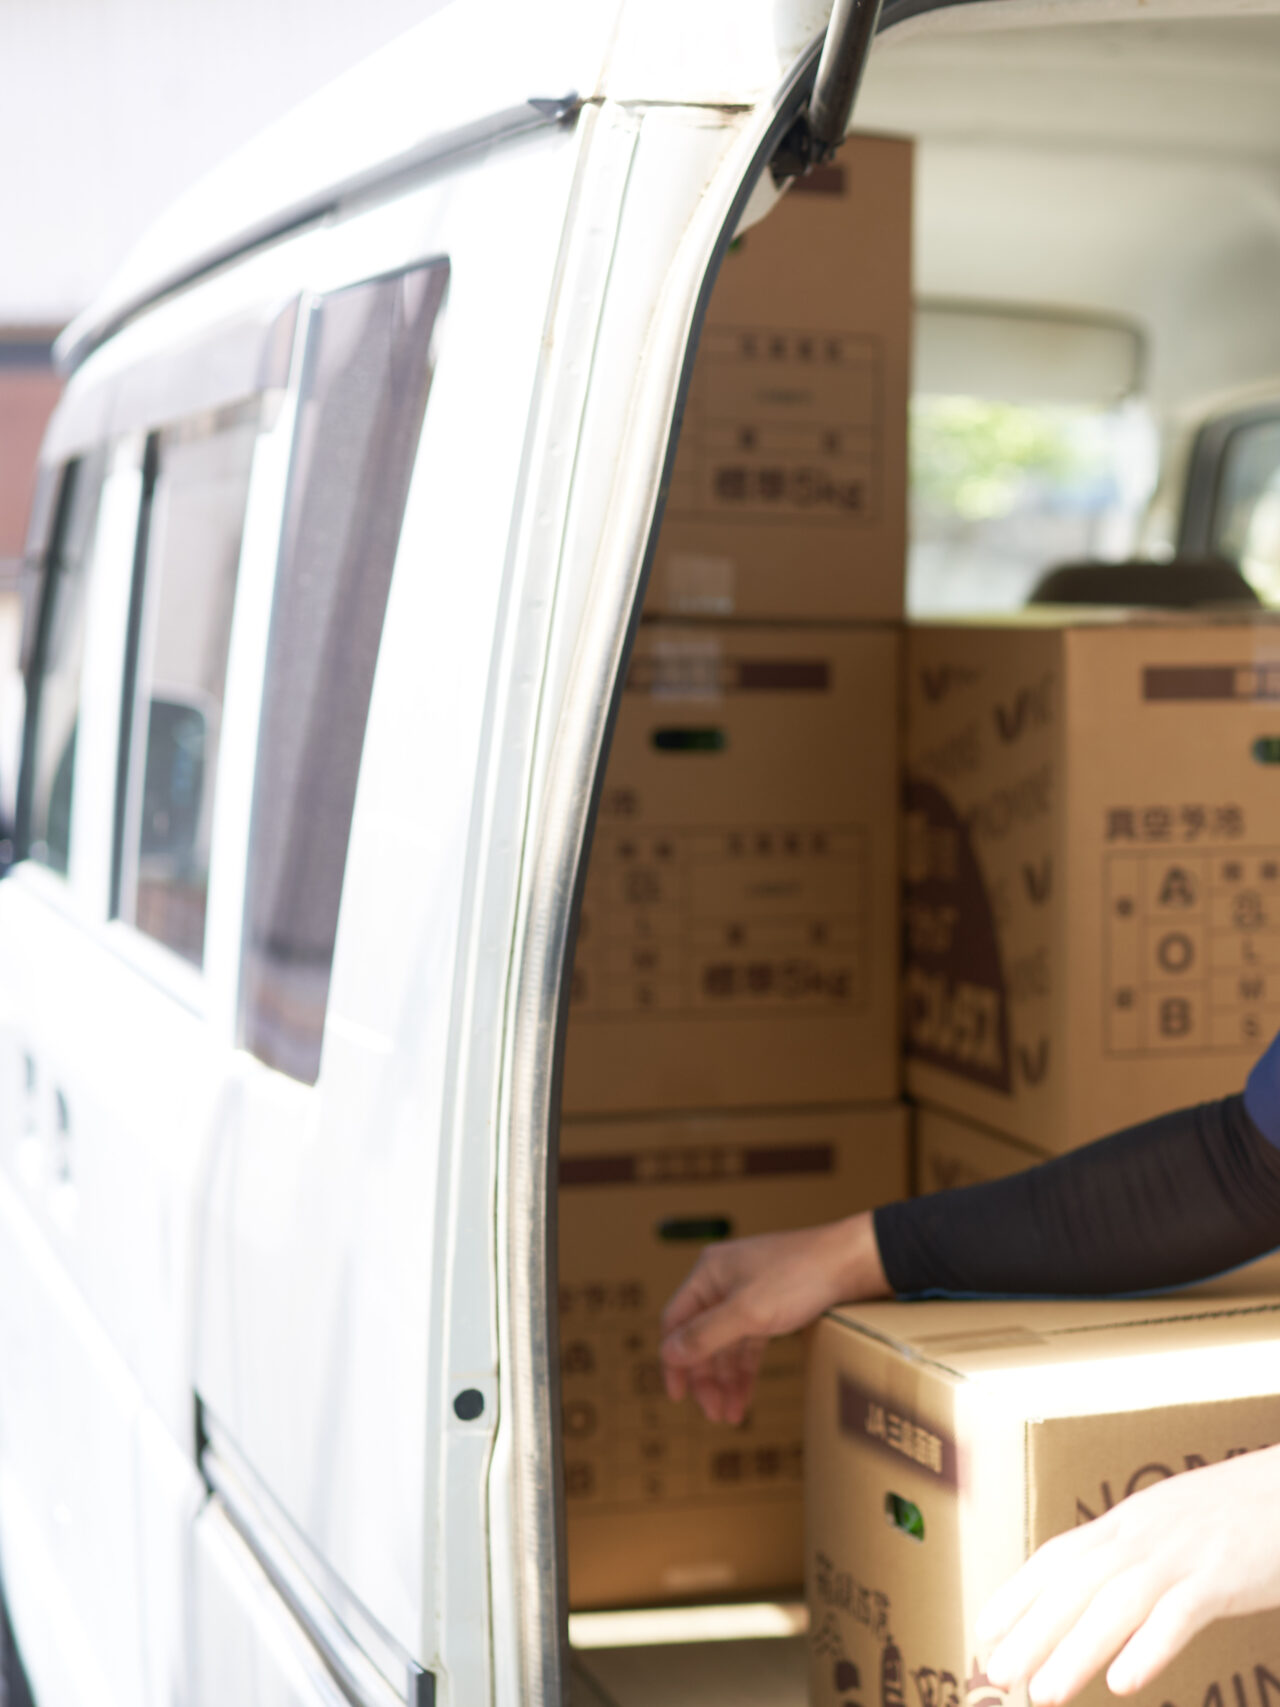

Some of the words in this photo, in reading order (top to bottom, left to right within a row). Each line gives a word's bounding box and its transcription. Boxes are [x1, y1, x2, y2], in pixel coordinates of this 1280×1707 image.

[1159, 866, 1195, 908] A
[1157, 932, 1195, 975] O
[1160, 996, 1193, 1039] B
